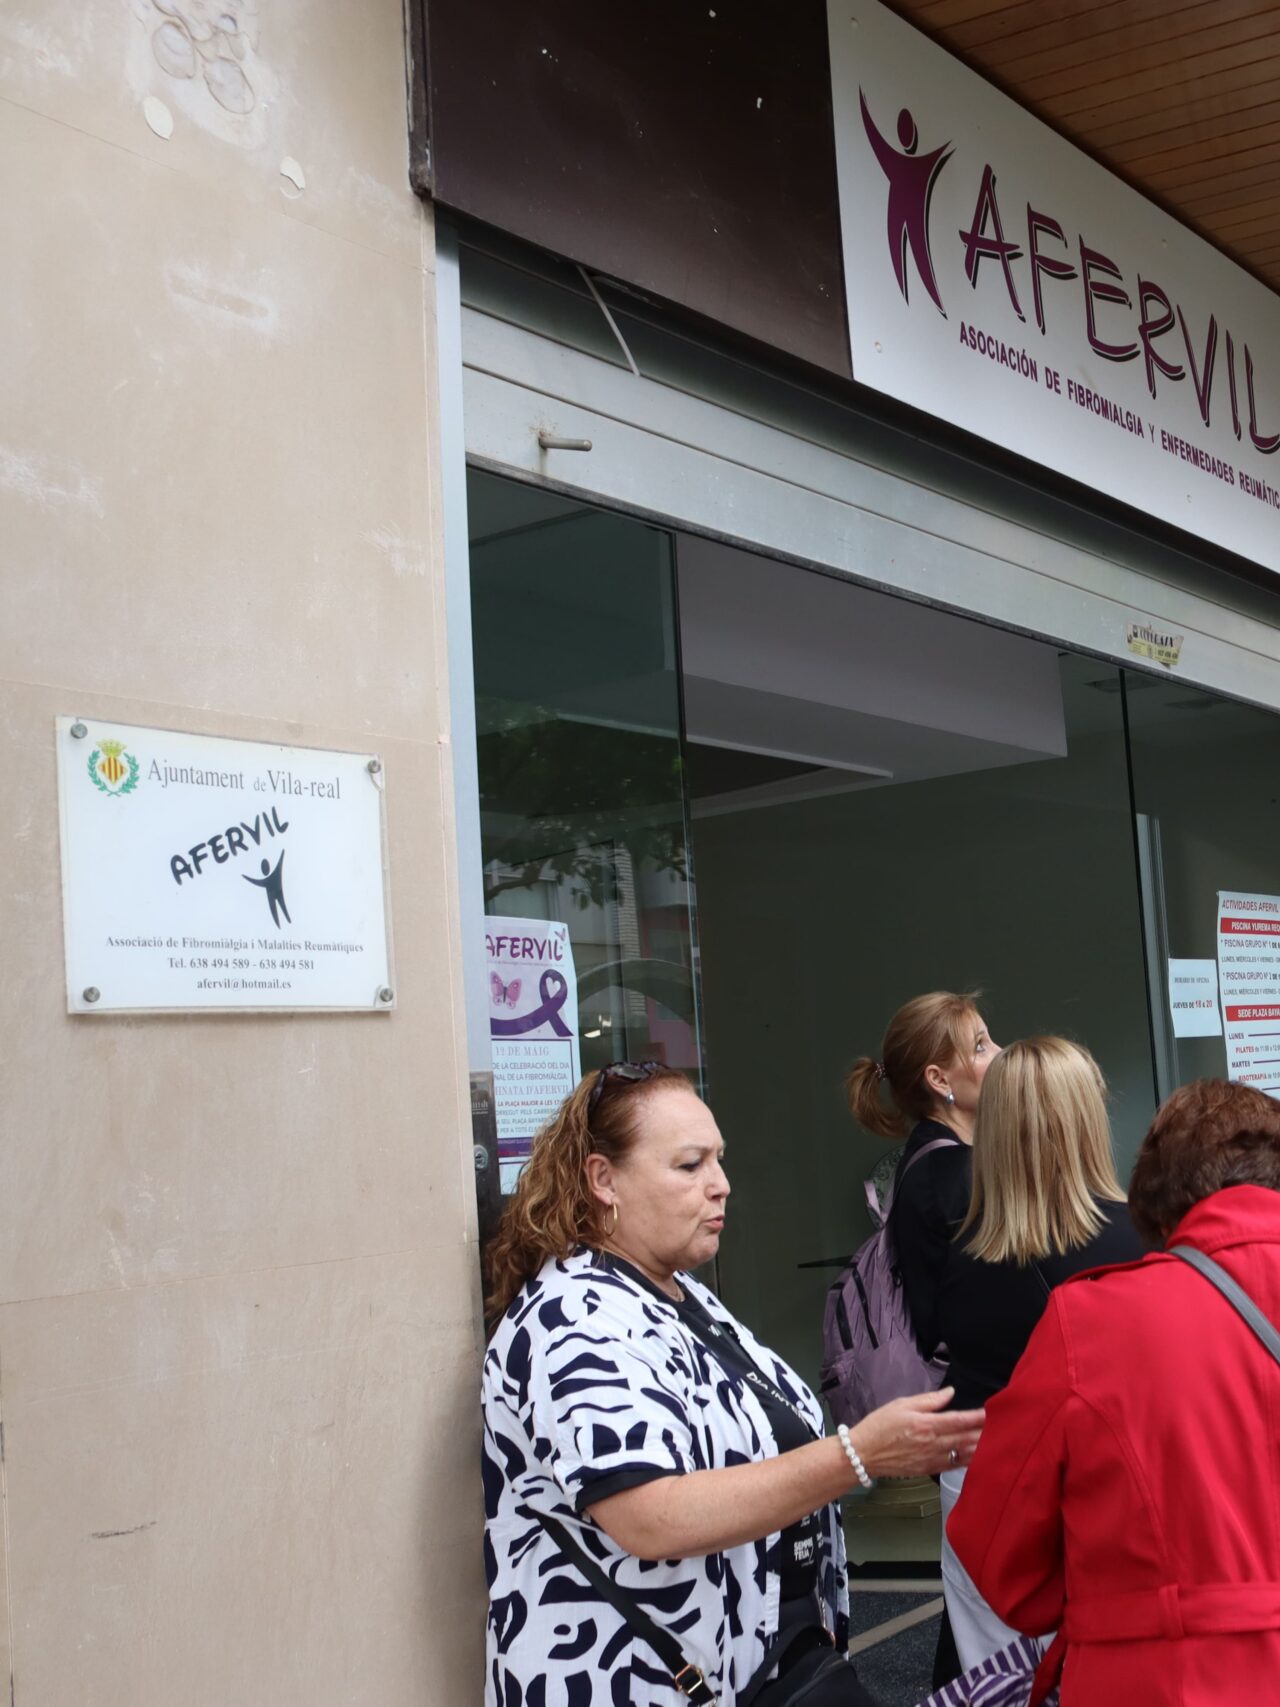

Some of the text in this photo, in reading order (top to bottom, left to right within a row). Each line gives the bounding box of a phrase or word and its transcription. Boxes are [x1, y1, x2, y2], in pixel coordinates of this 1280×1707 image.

[959, 321, 1039, 383] ASOCIACIÓN
[1044, 366, 1062, 395] DE
[1067, 378, 1145, 438] FIBROMIALGIA
[1149, 422, 1155, 443] Y
[1160, 429, 1235, 486] ENFERMEDADES
[148, 758, 341, 799] Ajuntament de Vila-real
[169, 805, 290, 886] AFERVIL
[1222, 899, 1258, 911] ACTIVIDADES
[1259, 902, 1278, 913] AFERVIL
[1231, 921, 1251, 931] PISCINA
[105, 936, 365, 955] Associació de Fibromiàlgia i Malalties Reumàtiques
[1224, 939, 1244, 948] PISCINA
[1245, 940, 1262, 948] GRUPO
[167, 957, 187, 969] Tel.
[190, 958, 208, 969] 638
[211, 958, 229, 969] 494
[232, 958, 250, 969] 589
[259, 959, 277, 970] 638
[279, 959, 297, 970] 494
[299, 959, 315, 970] 581
[1226, 972, 1246, 980] PISCINA
[1247, 972, 1264, 980] GRUPO
[197, 978, 292, 991] afervil@hotmail.es
[1238, 1008, 1251, 1018] SEDE
[1252, 1008, 1267, 1018] PLAZA
[1229, 1032, 1244, 1040] LUNES
[508, 1046, 521, 1056] DE
[524, 1046, 549, 1056] MAIG
[1235, 1046, 1254, 1054] PILATES
[510, 1061, 546, 1069] CELEBRACIÓ
[1232, 1060, 1250, 1068] MARTES
[1238, 1073, 1267, 1081] RISOTERAPIA
[746, 1371, 769, 1391] DIA
